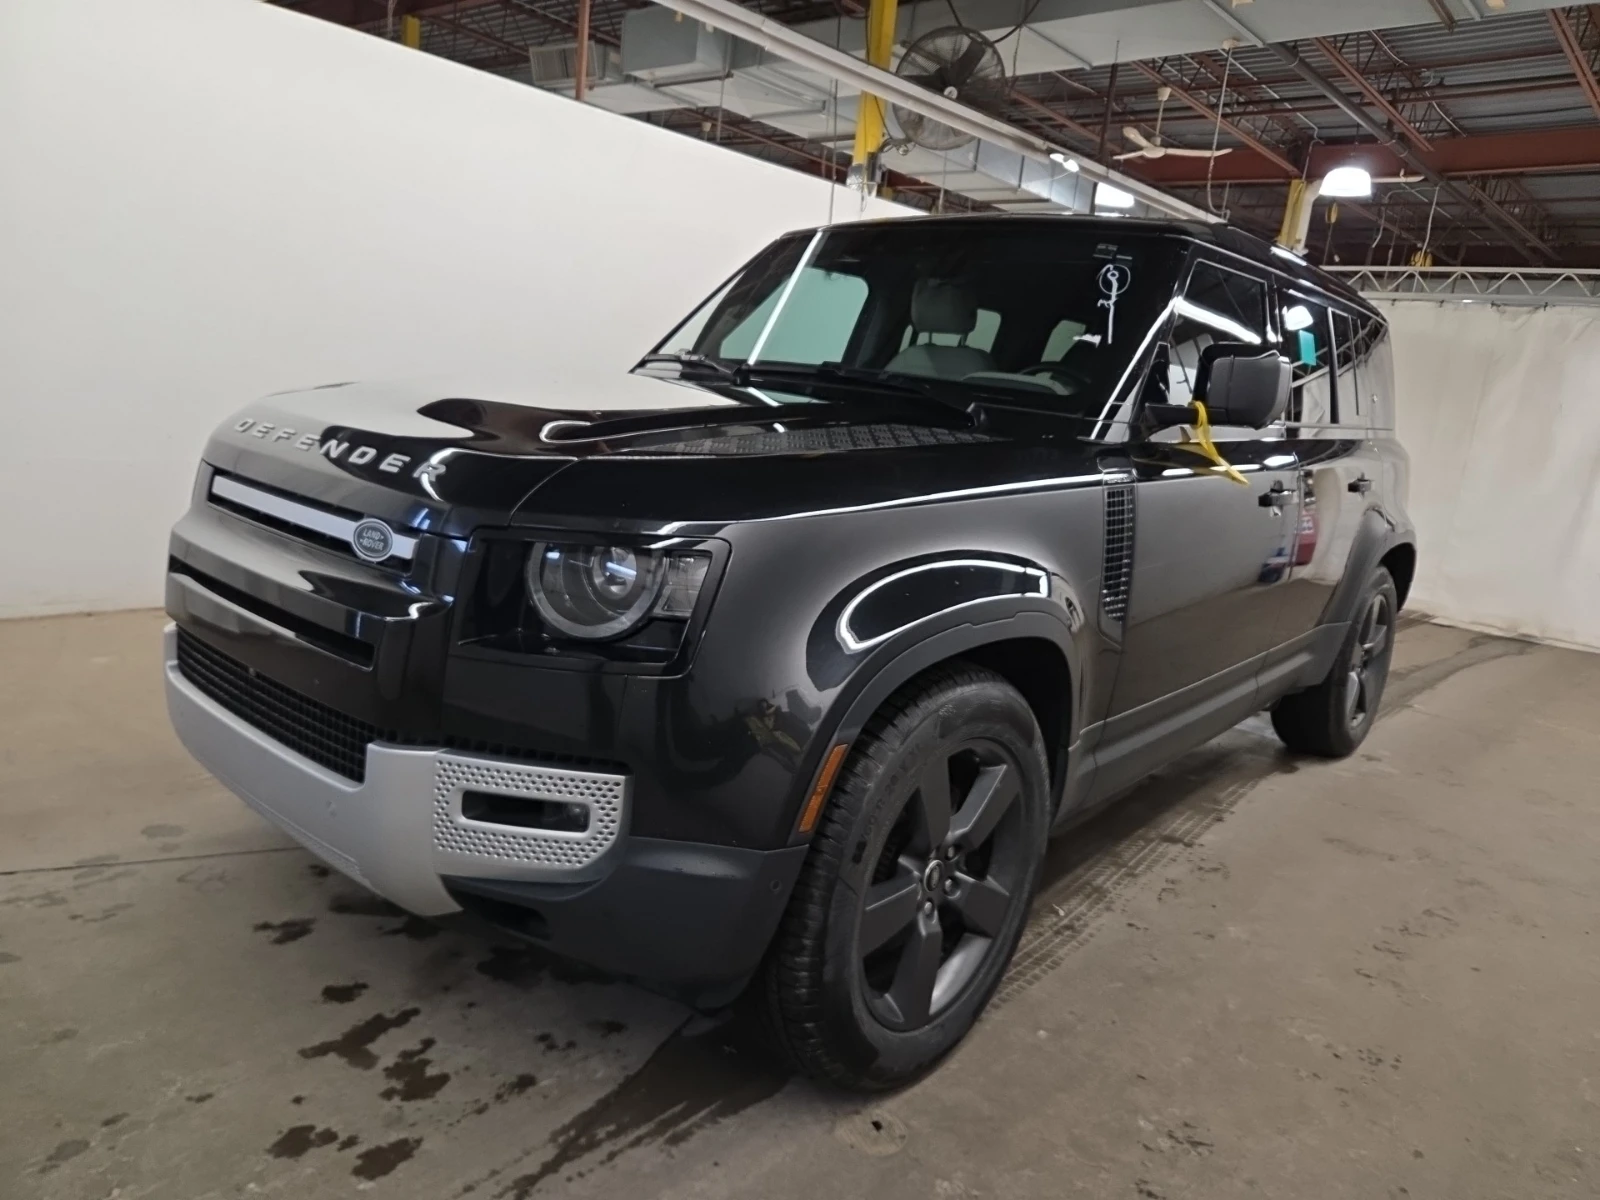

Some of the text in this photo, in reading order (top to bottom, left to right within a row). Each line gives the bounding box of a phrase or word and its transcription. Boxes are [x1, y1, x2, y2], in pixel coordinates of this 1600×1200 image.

[235, 418, 446, 482] DEFENDER
[362, 528, 381, 541] LAND
[362, 538, 385, 551] ROVER
